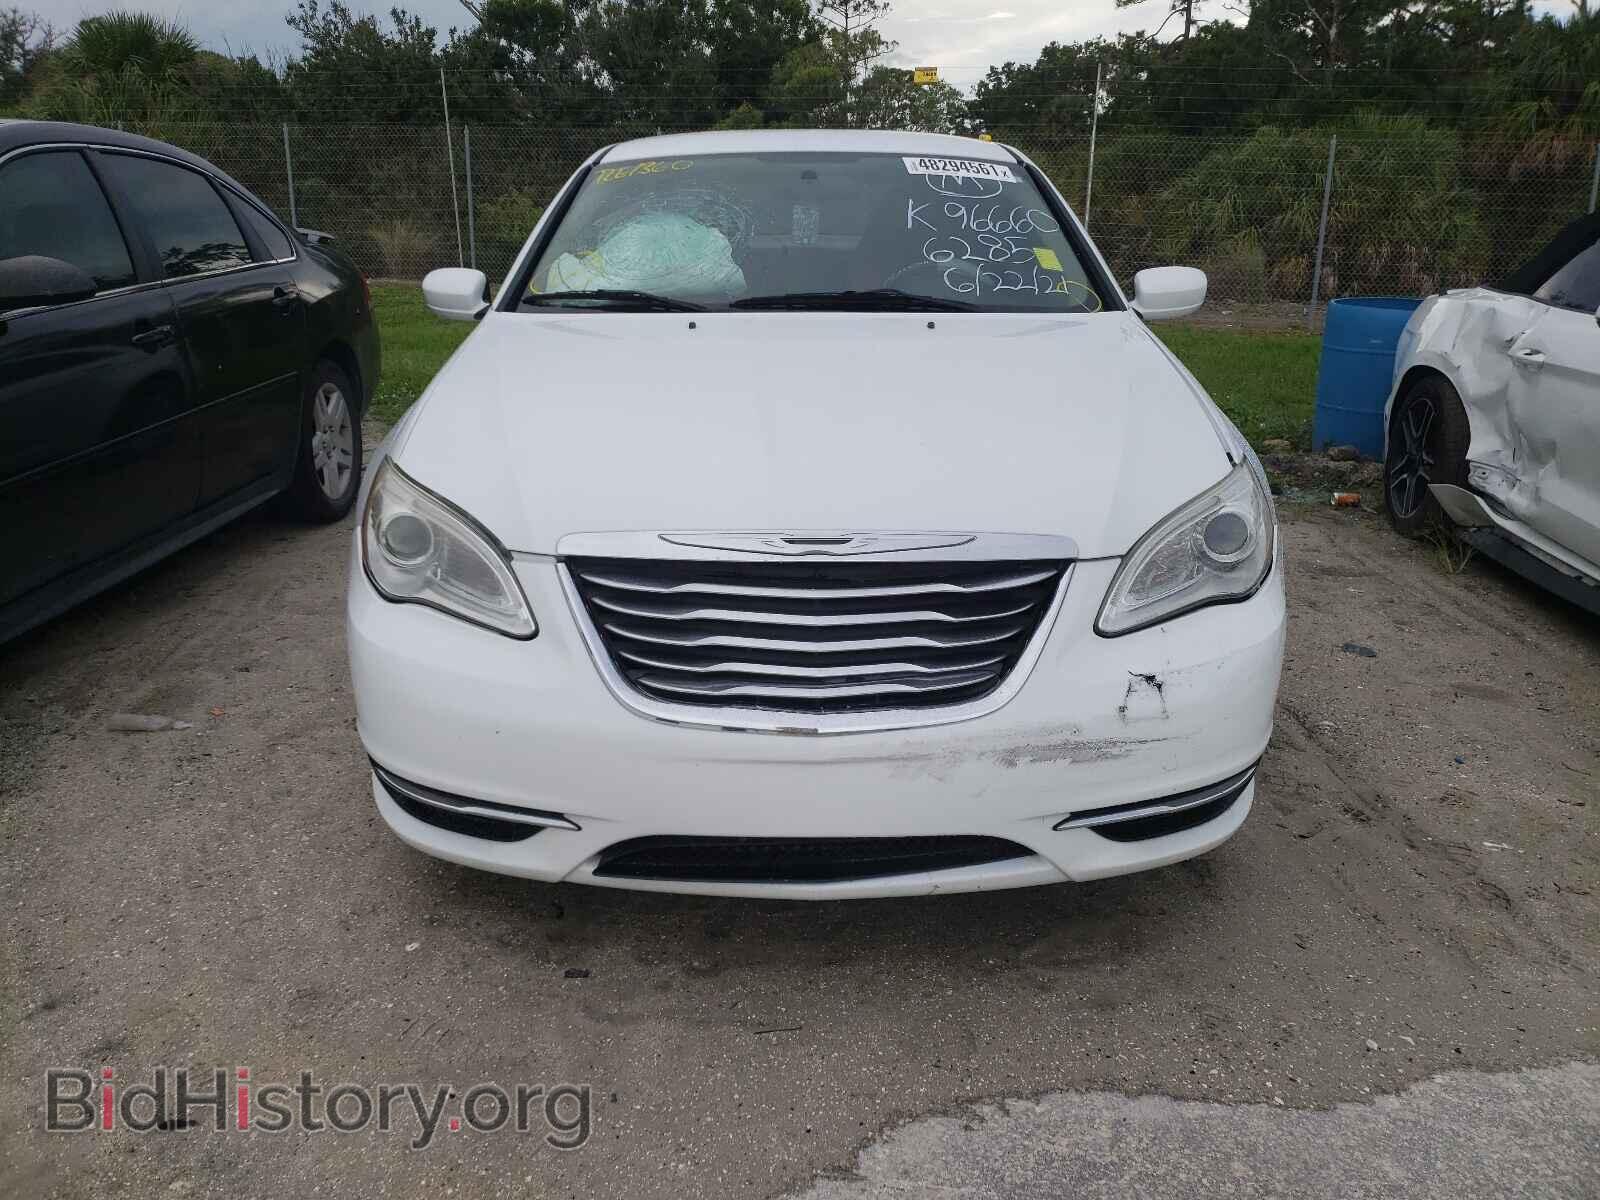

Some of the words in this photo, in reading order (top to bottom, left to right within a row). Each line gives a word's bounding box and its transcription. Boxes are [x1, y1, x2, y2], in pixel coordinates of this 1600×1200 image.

[919, 158, 999, 177] 48294561
[907, 199, 937, 232] K
[944, 202, 1060, 233] 96660
[923, 234, 1035, 264] 6285
